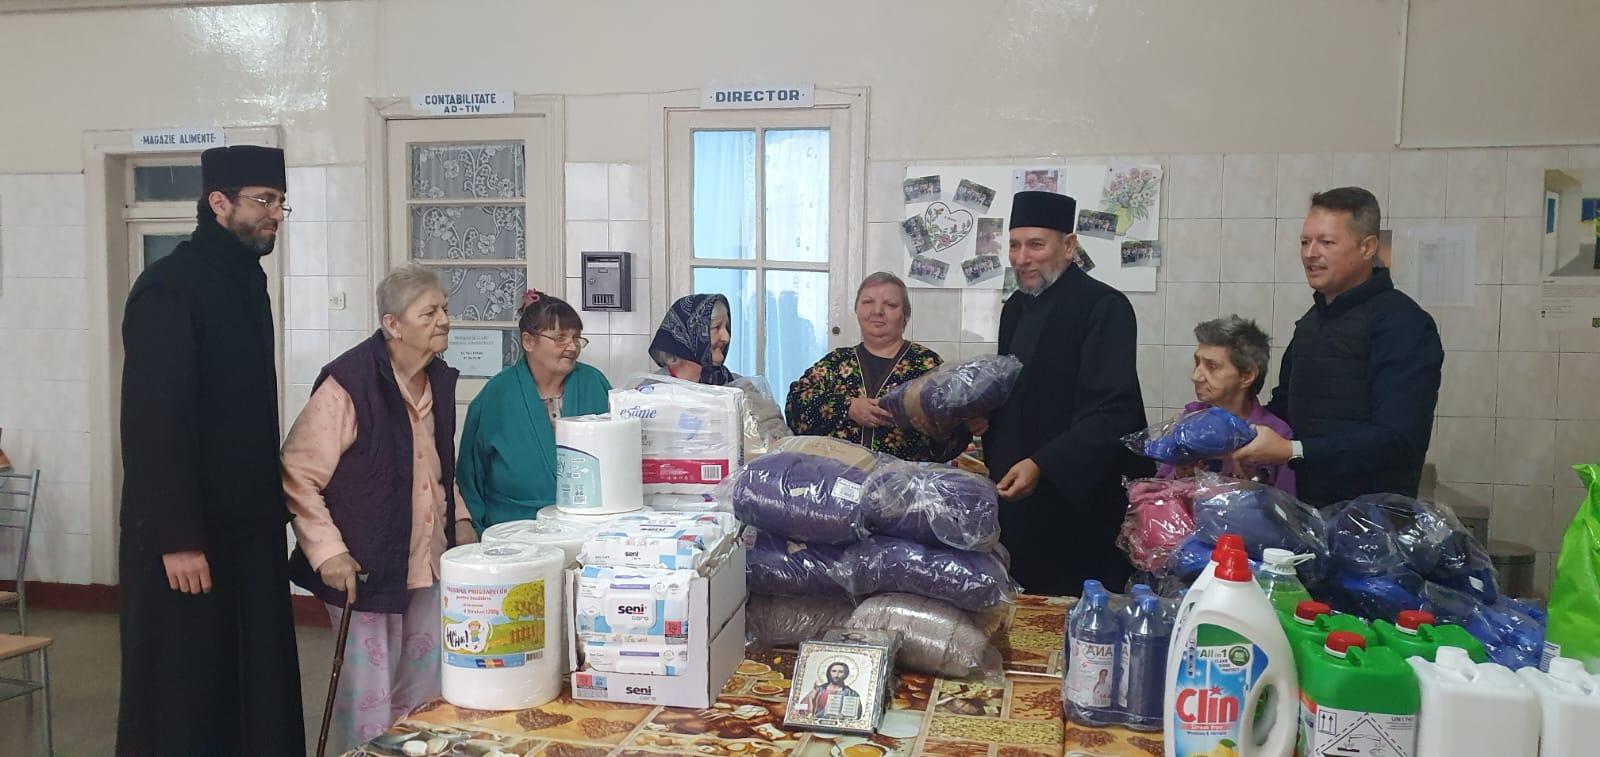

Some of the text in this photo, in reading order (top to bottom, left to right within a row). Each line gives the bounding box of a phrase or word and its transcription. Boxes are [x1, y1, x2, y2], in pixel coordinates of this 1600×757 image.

[424, 93, 497, 105] CONTABILITATE
[715, 89, 800, 102] DIRECTOR
[443, 105, 481, 113] AD-TIV
[142, 133, 215, 145] MAGAZIE ALIMENTE
[617, 603, 645, 615] seni
[1200, 649, 1214, 658] All
[1221, 649, 1227, 658] 1
[625, 686, 652, 695] seni
[1176, 686, 1239, 723] Clin
